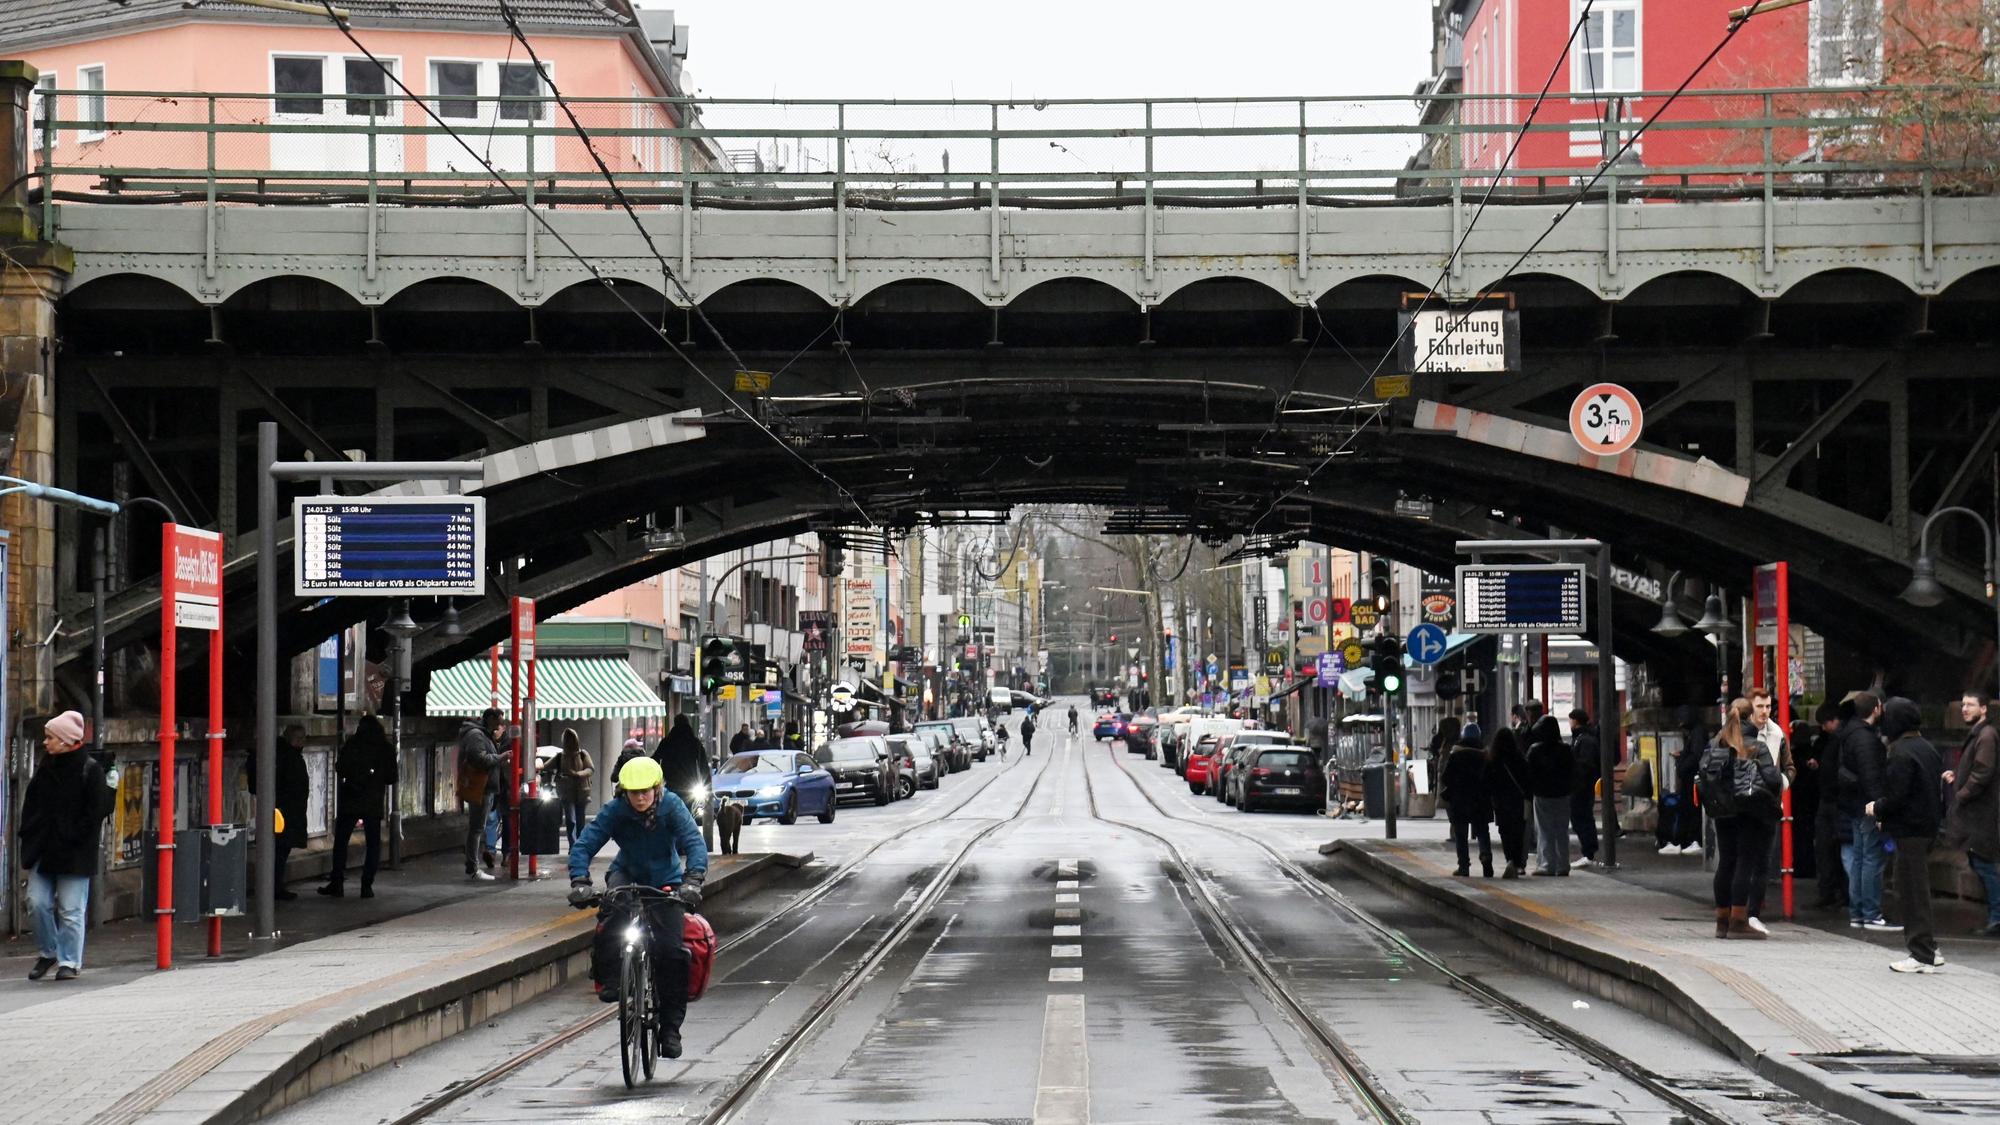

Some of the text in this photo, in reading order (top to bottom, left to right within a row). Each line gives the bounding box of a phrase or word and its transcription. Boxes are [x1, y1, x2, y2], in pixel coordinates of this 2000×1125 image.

[327, 552, 342, 560] Sülz
[327, 561, 342, 569] Sülz
[457, 561, 471, 569] Min
[416, 580, 449, 588] Chipkarte
